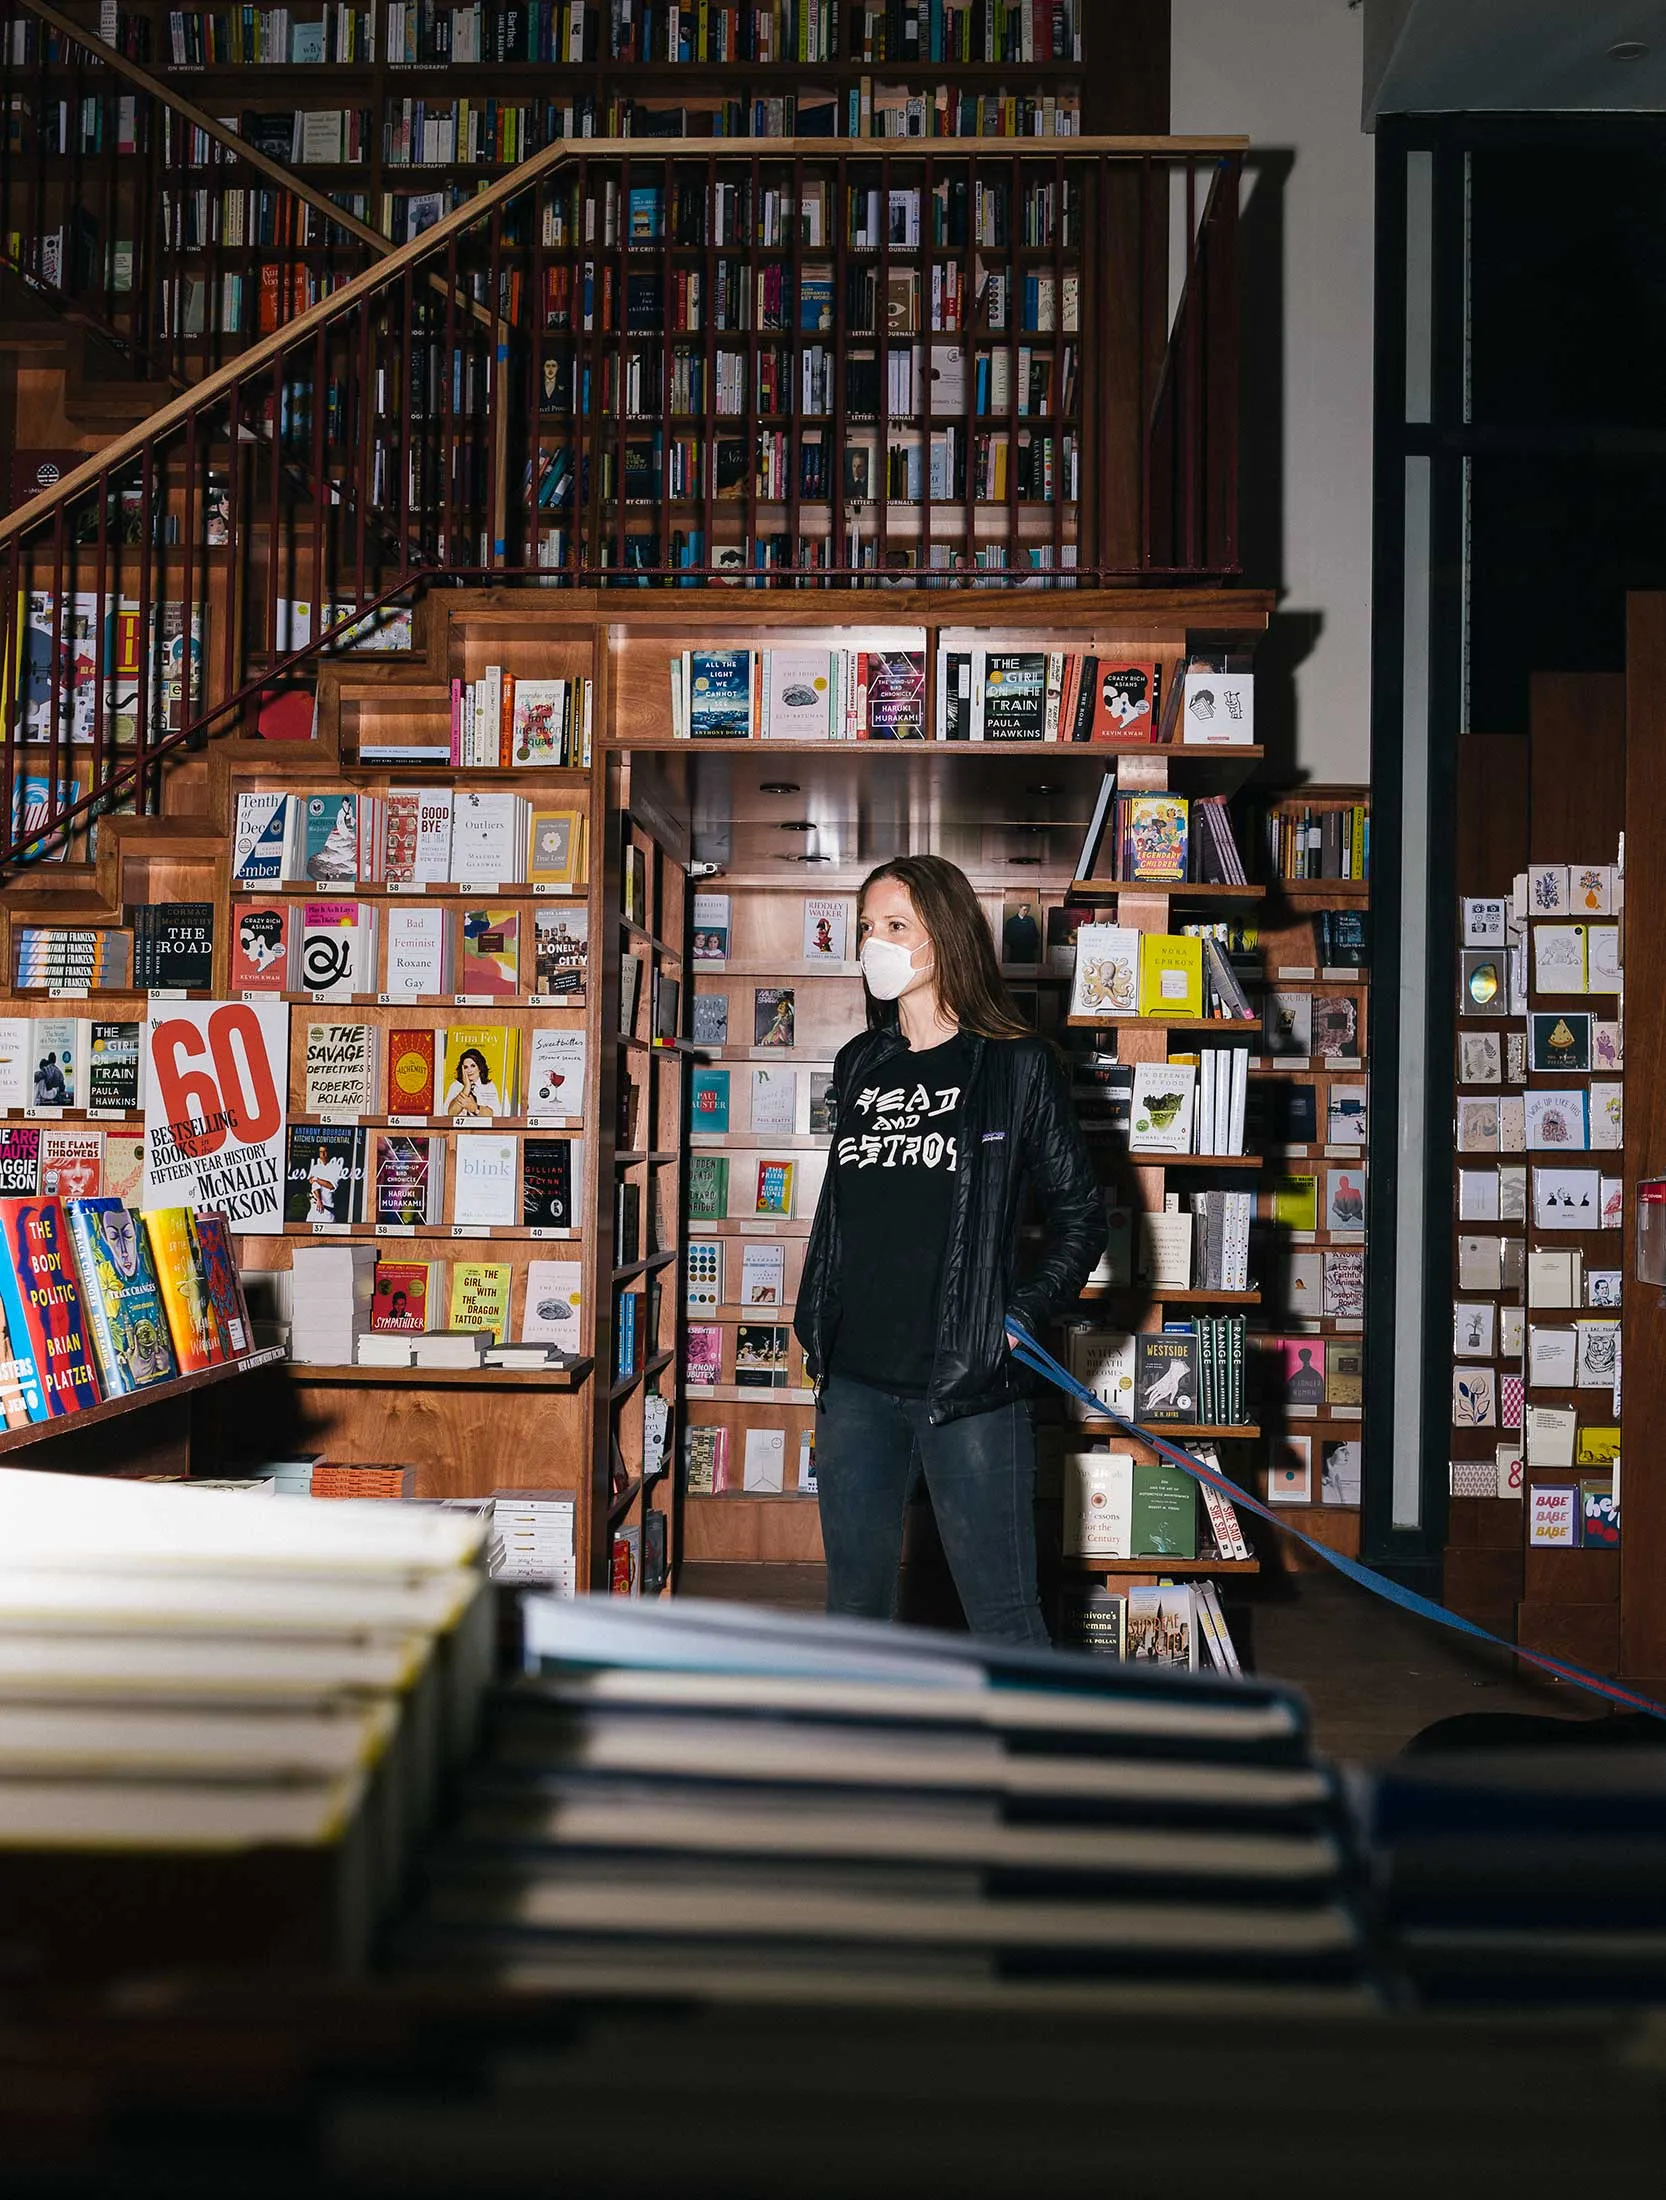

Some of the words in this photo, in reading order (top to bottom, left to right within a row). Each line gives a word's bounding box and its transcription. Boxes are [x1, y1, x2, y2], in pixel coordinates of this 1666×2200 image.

[507, 11, 518, 48] Barthes
[991, 658, 1020, 669] THE
[1005, 672, 1040, 683] GIRL
[987, 686, 1008, 698] ON
[1014, 686, 1040, 697] THE
[991, 700, 1038, 711] TRAIN
[528, 713, 551, 724] from
[875, 714, 919, 722] MURAKAMI
[987, 719, 1021, 727] PAULA
[516, 725, 533, 735] the
[535, 726, 561, 737] goon
[992, 730, 1040, 738] HAWKINS
[523, 736, 554, 748] squad
[240, 795, 279, 809] Tenth
[241, 809, 253, 820] of
[421, 807, 449, 820] GOOD
[240, 821, 266, 835] Dec
[421, 820, 442, 833] BYE
[464, 820, 505, 831] Outliers
[1137, 851, 1181, 860] LEGENDARY
[1140, 860, 1178, 868] CHILDREN
[238, 862, 280, 878] ember
[245, 881, 255, 889] 56
[318, 883, 328, 891] 57
[808, 902, 844, 910] RIDDLEY
[809, 910, 843, 918] WALKER
[268, 917, 281, 925] RICH
[406, 918, 424, 929] Bad
[167, 927, 205, 940] THE
[160, 941, 212, 954] ROAD
[394, 937, 435, 948] Feminist
[538, 943, 575, 955] LONELY
[396, 958, 432, 968] Roxane
[558, 955, 588, 967] CITY
[404, 977, 425, 990] Gay
[51, 989, 61, 997] 49
[150, 990, 160, 998] 50
[380, 995, 390, 1003] 53
[456, 996, 466, 1004] 54
[95, 1027, 120, 1038] THE
[329, 1026, 365, 1043] THE
[453, 1031, 478, 1043] Tina
[481, 1031, 499, 1047] Fey
[107, 1041, 140, 1052] GIRL
[307, 1044, 365, 1063] SAVAGE
[91, 1054, 110, 1066] ON
[114, 1054, 138, 1065] THE
[95, 1068, 134, 1079] TRAIN
[306, 1064, 364, 1074] DETECTIVES
[151, 1003, 281, 1157] 60
[91, 1087, 120, 1095] PAULA
[311, 1080, 364, 1092] ROBERTO
[317, 1092, 364, 1105] BOLAÑO
[697, 1091, 720, 1100] PAUL
[95, 1097, 136, 1106] HAWKINS
[321, 1115, 332, 1123] 45
[390, 1117, 400, 1125] 46
[455, 1118, 465, 1126] 47
[529, 1118, 539, 1126] 48
[872, 1114, 921, 1131] AND
[150, 1109, 239, 1147] BESTSELLING
[47, 1140, 66, 1149] THE
[68, 1141, 100, 1150] FLAME
[293, 1135, 315, 1143] KITCHEN
[315, 1135, 351, 1145] CONFIDENTIAL
[47, 1149, 99, 1158] THROWERS
[150, 1139, 198, 1168] BOOKS
[150, 1161, 194, 1185] FIFTEEN
[194, 1155, 223, 1174] YEAR
[223, 1143, 267, 1167] HISTORY
[463, 1158, 511, 1177] blink
[188, 1185, 198, 1199] of
[196, 1157, 279, 1201] McNALLY
[29, 1220, 53, 1241] THE
[377, 1226, 388, 1234] 38
[453, 1228, 463, 1236] 39
[532, 1229, 543, 1237] 40
[31, 1252, 62, 1274] BODY
[484, 1269, 499, 1279] THE
[463, 1278, 482, 1288] GIRL
[30, 1283, 76, 1309] POLITIC
[110, 1287, 131, 1300] TRACK
[131, 1283, 157, 1296] CHANGES
[477, 1287, 497, 1297] WITH
[462, 1295, 477, 1305] THE
[467, 1305, 500, 1316] DRAGON
[374, 1317, 425, 1329] SYMPATHIZER
[455, 1314, 483, 1325] TATTOO
[46, 1333, 81, 1358] BRIAN
[1201, 1326, 1212, 1366] RANGE
[1217, 1326, 1226, 1366] RANGE
[1232, 1326, 1242, 1366] RANGE
[1146, 1345, 1189, 1358] WESTSIDE
[45, 1364, 95, 1393] PLATZER
[1536, 1496, 1569, 1509] BABE
[1209, 1505, 1221, 1522] SHE
[1223, 1506, 1235, 1523] SHE
[1536, 1511, 1569, 1524] BABE
[1214, 1522, 1229, 1541] SAID
[1228, 1523, 1242, 1542] SAID
[1535, 1526, 1569, 1539] BABE
[1087, 1534, 1121, 1544] Century
